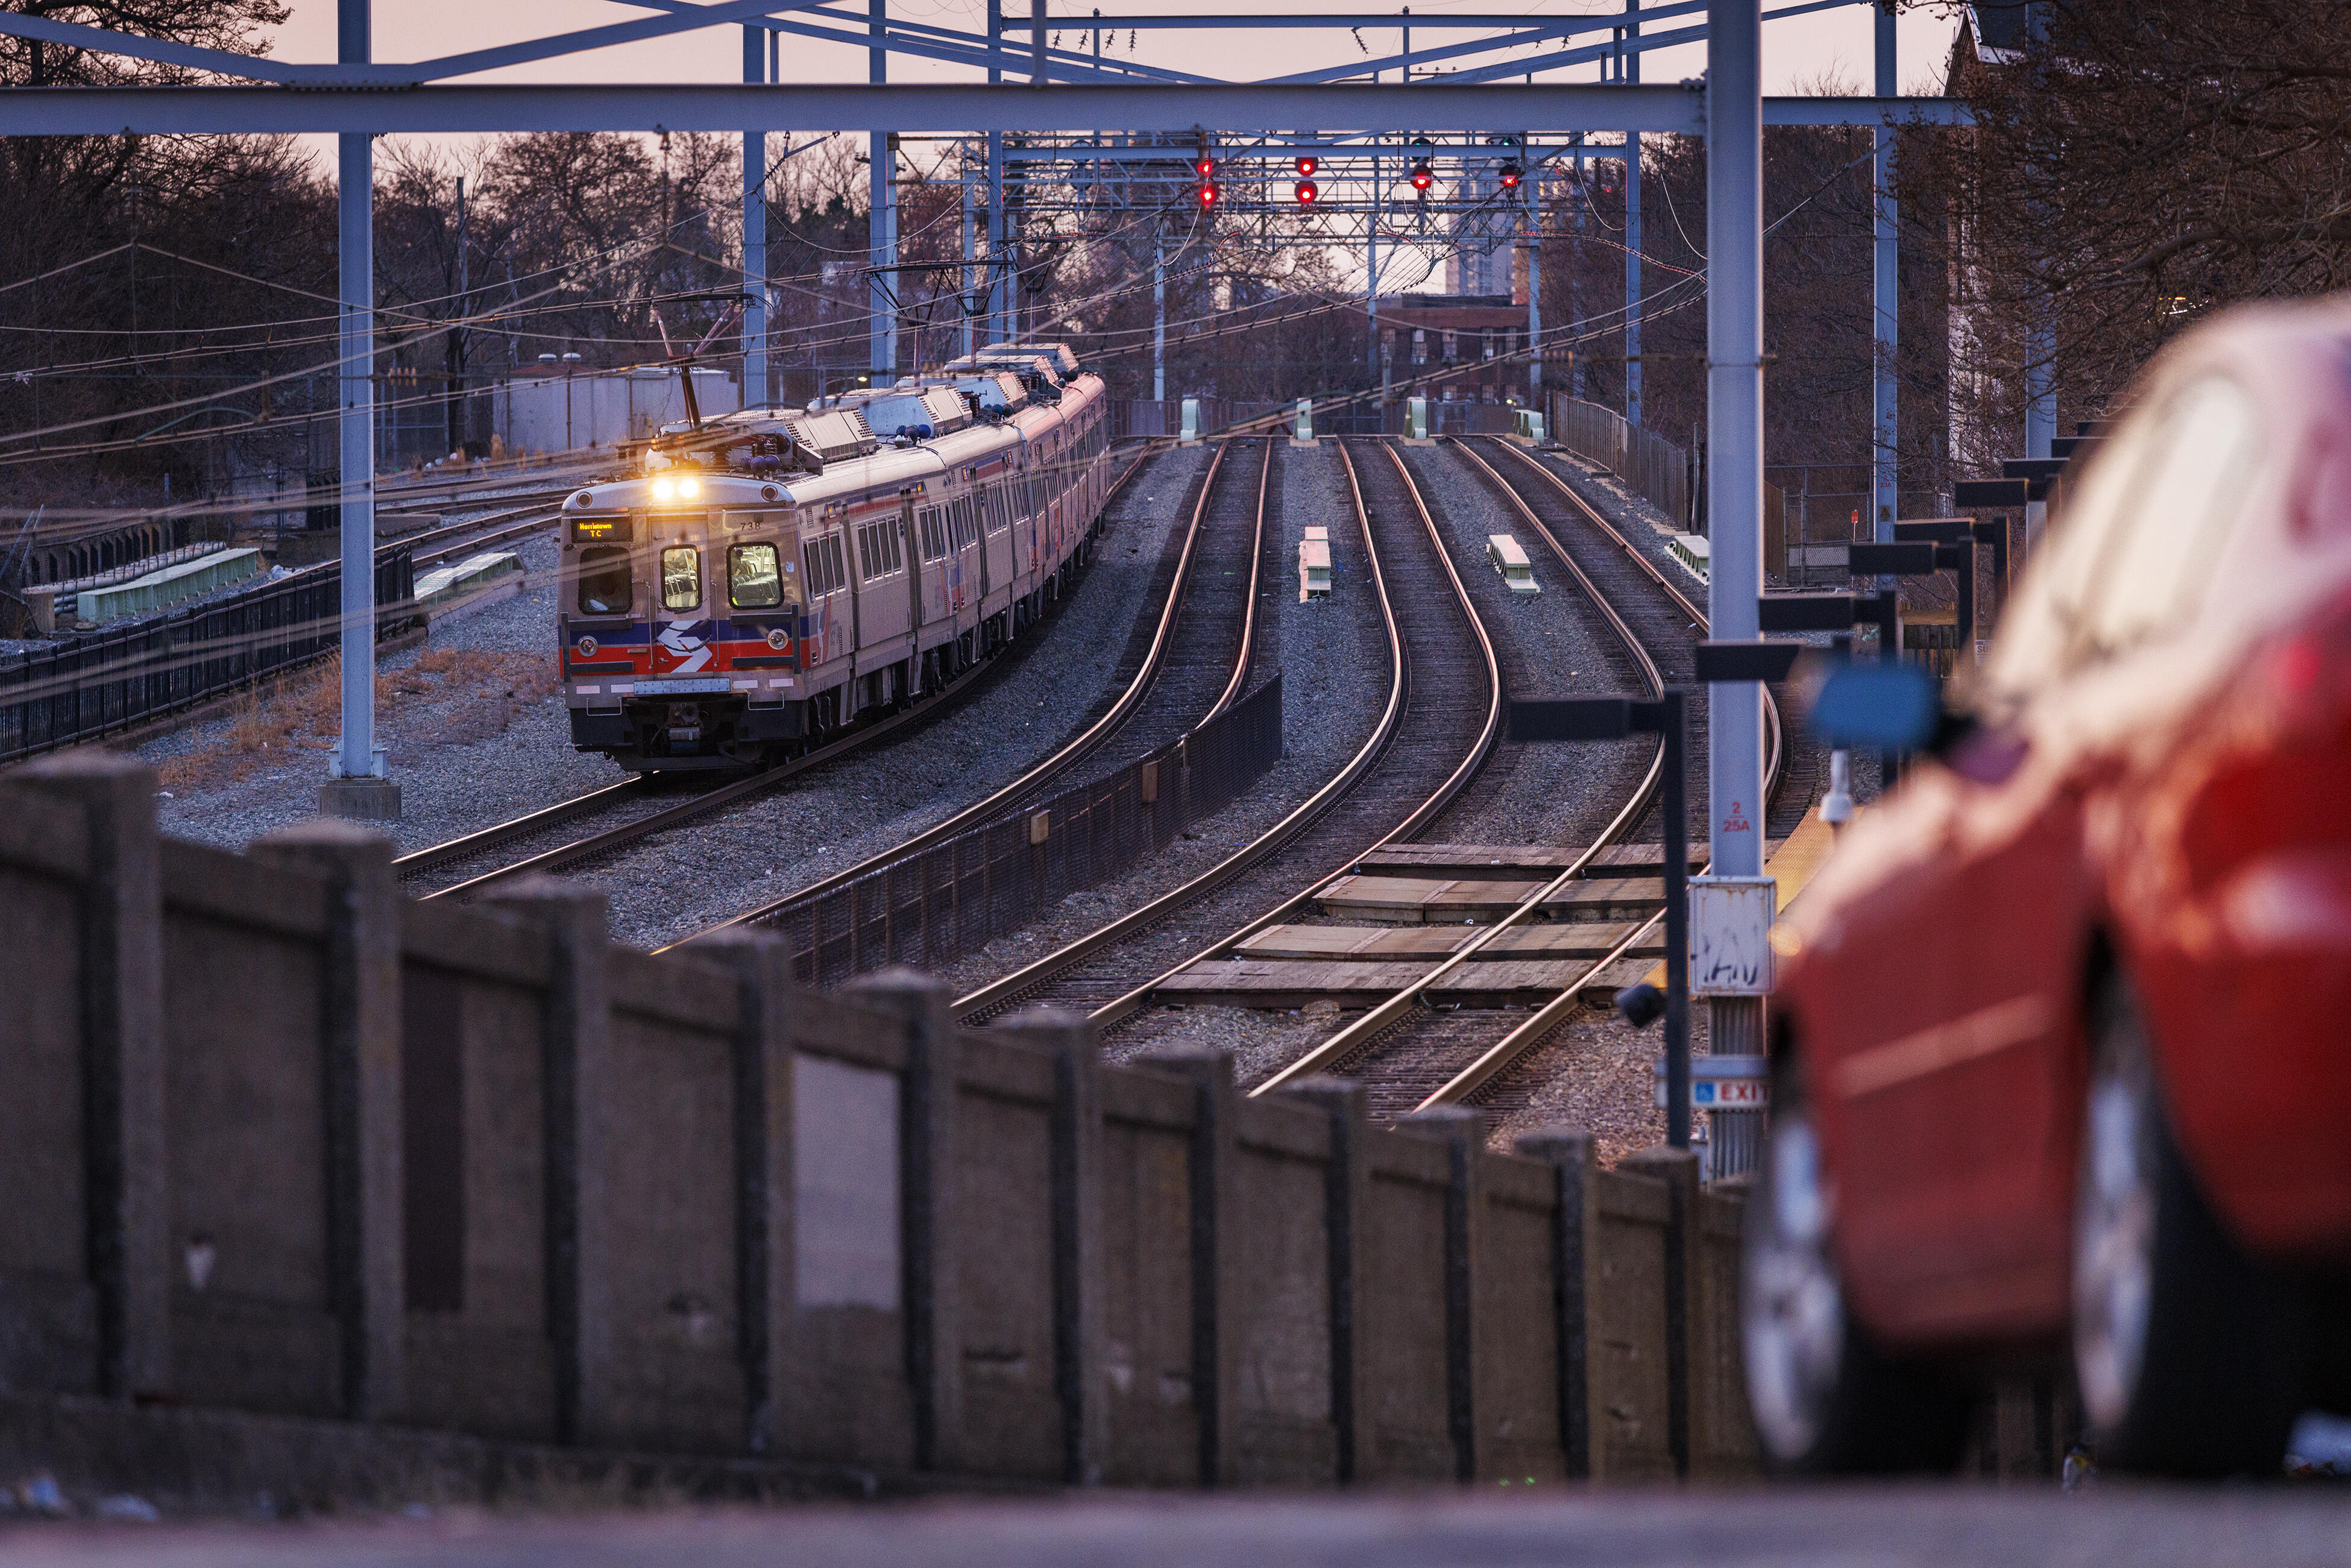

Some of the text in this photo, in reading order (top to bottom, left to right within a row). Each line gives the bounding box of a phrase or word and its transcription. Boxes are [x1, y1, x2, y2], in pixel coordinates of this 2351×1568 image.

[741, 522, 761, 531] 738
[1732, 802, 1741, 814] 2
[1723, 820, 1751, 833] 25A
